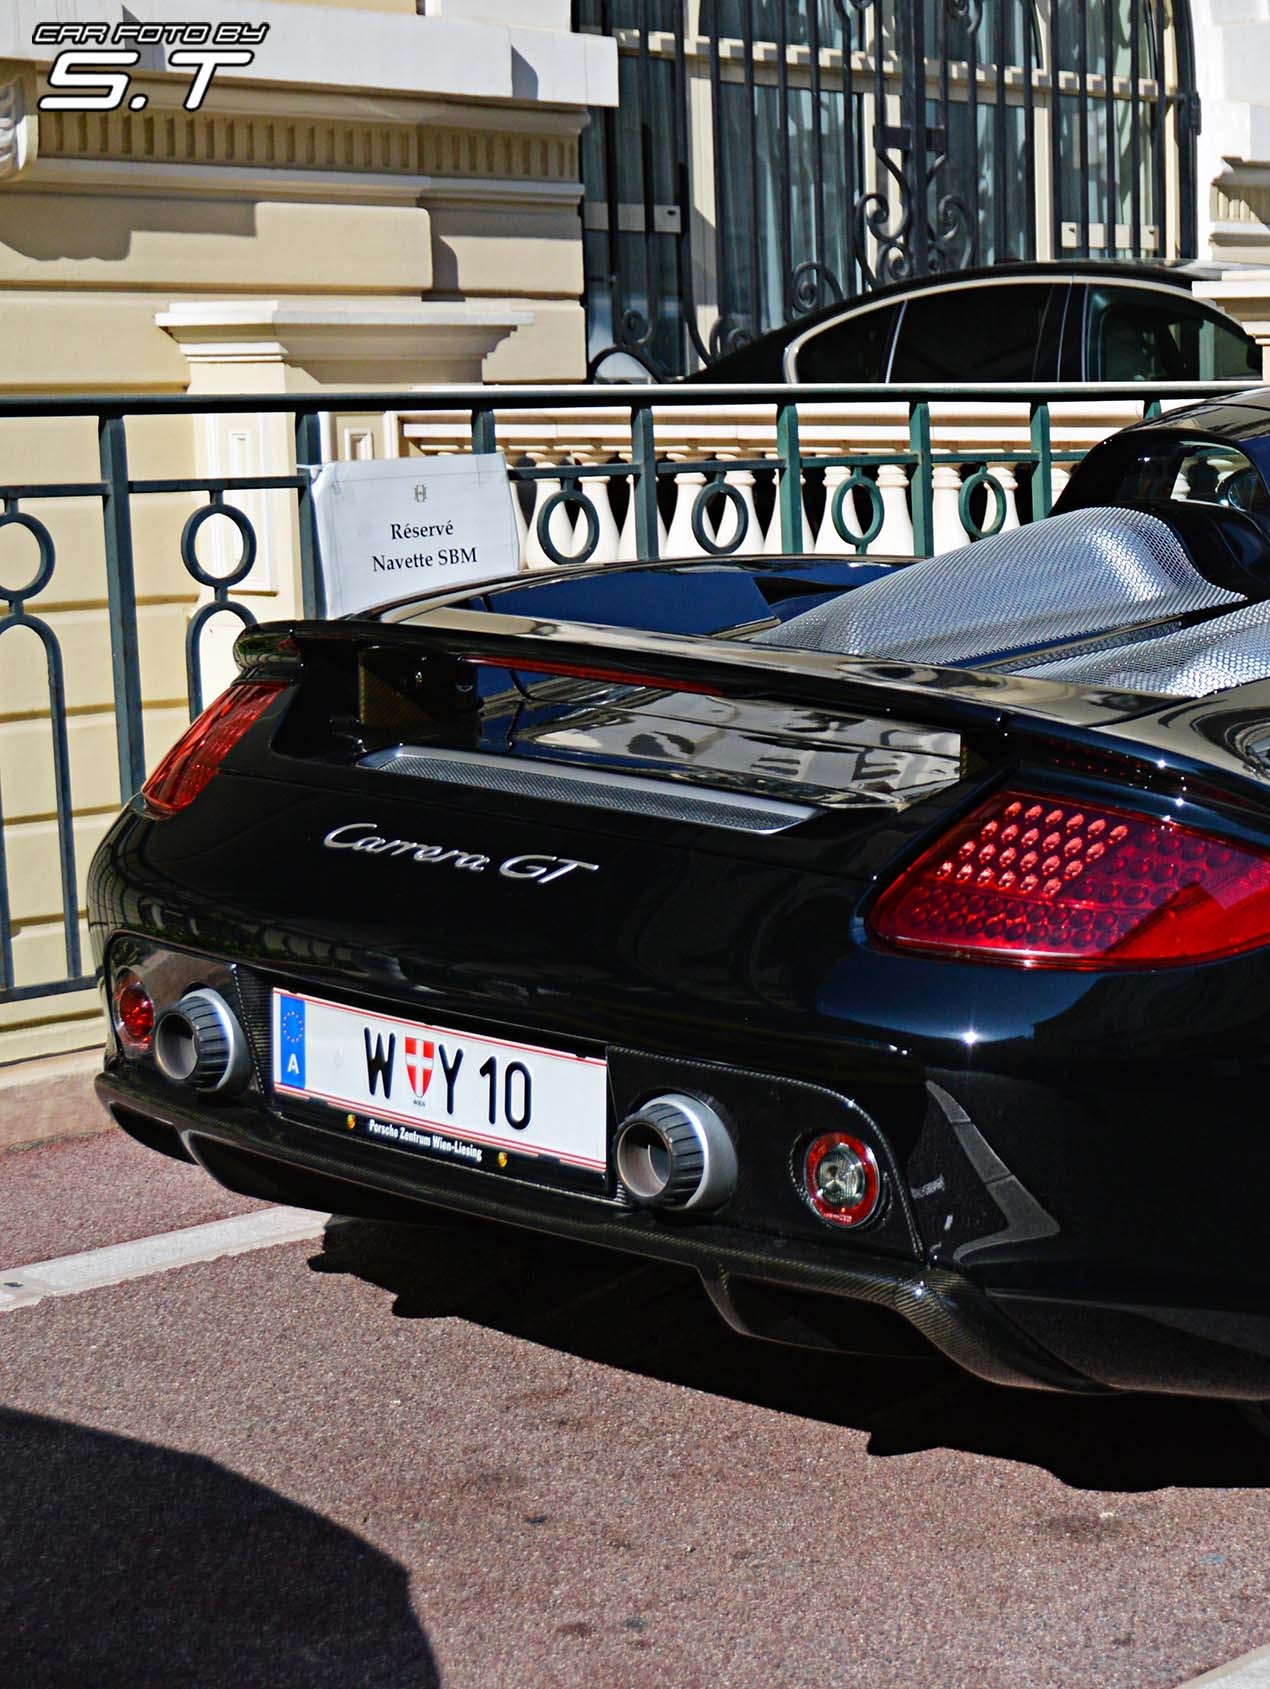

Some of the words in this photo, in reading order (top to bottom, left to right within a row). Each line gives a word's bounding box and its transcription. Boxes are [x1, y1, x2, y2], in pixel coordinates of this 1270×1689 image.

[391, 520, 454, 540] Réservé
[372, 554, 433, 572] Navette
[438, 547, 477, 566] SBM
[324, 823, 490, 872] Carrera
[500, 854, 599, 884] GT
[287, 1053, 300, 1074] A
[364, 1026, 396, 1099] W
[369, 1118, 399, 1138] Porsche
[400, 1127, 431, 1147] Zentrum
[432, 1135, 482, 1162] Wien-Liesing
